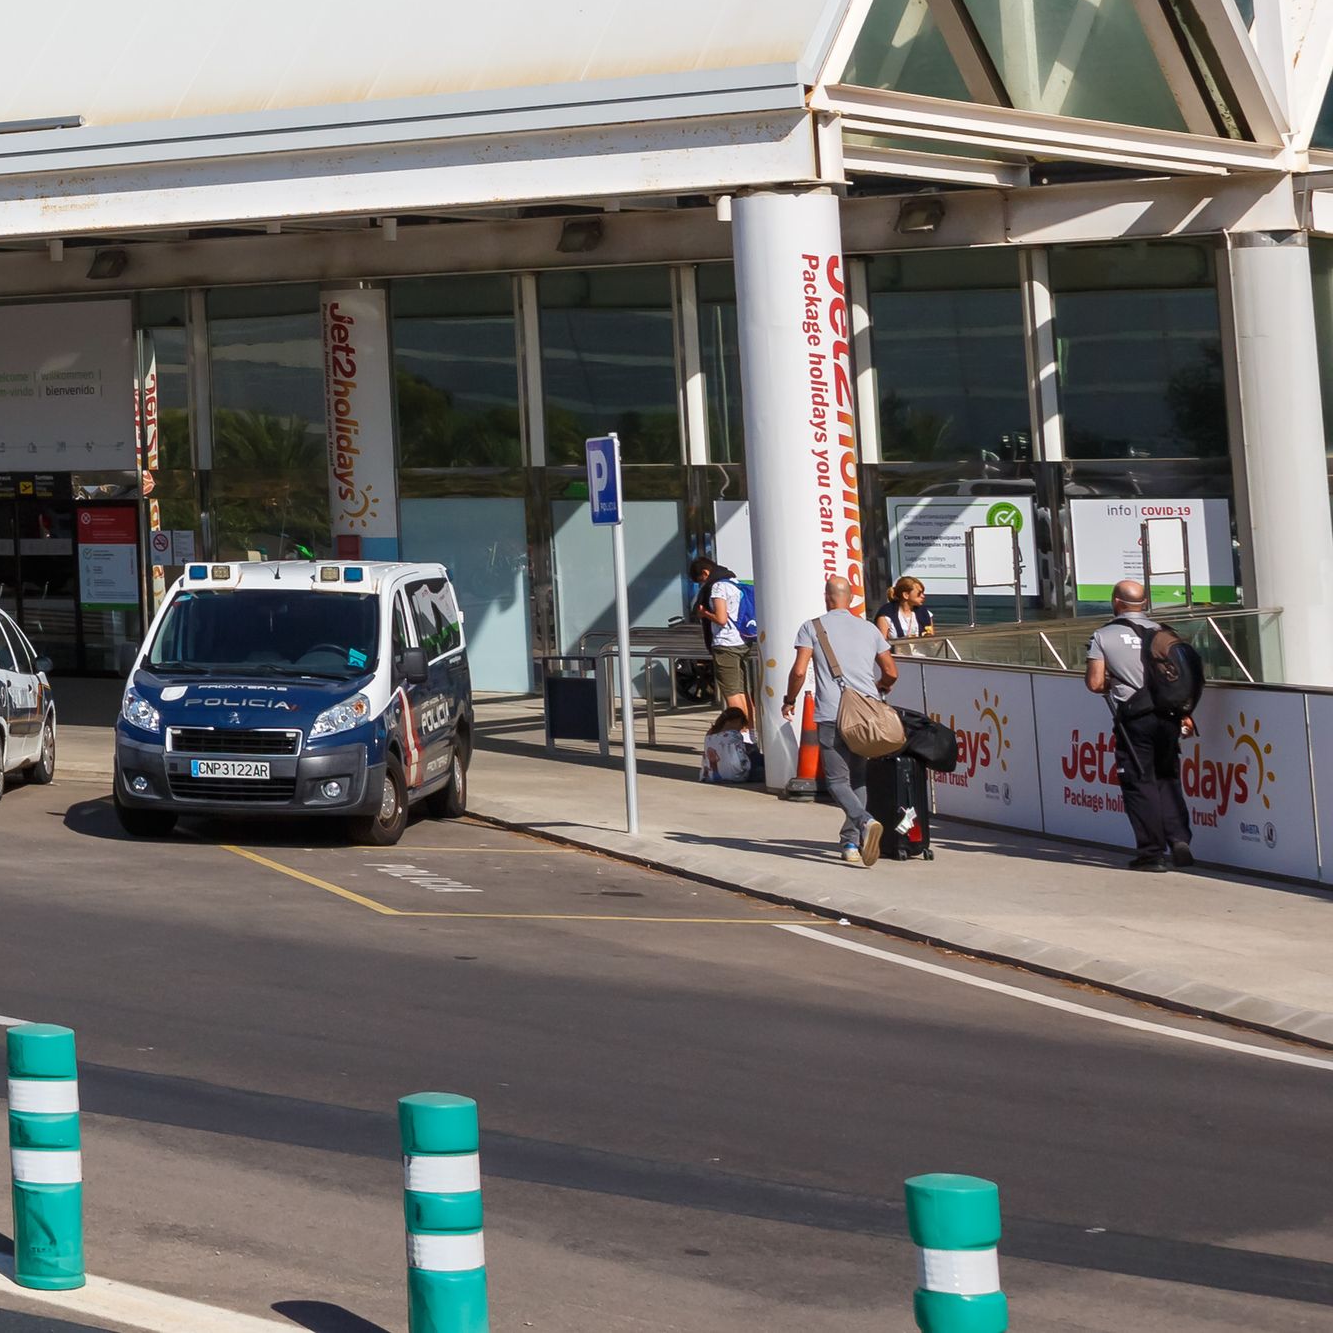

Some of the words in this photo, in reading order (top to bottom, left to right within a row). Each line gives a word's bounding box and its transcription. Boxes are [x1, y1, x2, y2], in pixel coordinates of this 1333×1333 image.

[801, 253, 822, 347] Package
[42, 371, 95, 380] willkommen
[46, 386, 95, 396] bienvenido
[330, 302, 361, 502] Jet2holidays
[809, 353, 830, 445] holidays
[589, 450, 608, 512] P
[811, 449, 831, 489] you
[819, 493, 835, 535] can
[1107, 505, 1132, 516] info
[1141, 506, 1191, 516] COVID-19
[821, 540, 839, 585] trus
[949, 771, 969, 787] trust
[1064, 786, 1104, 813] Package
[1105, 792, 1125, 812] holi
[1192, 807, 1219, 828] trust
